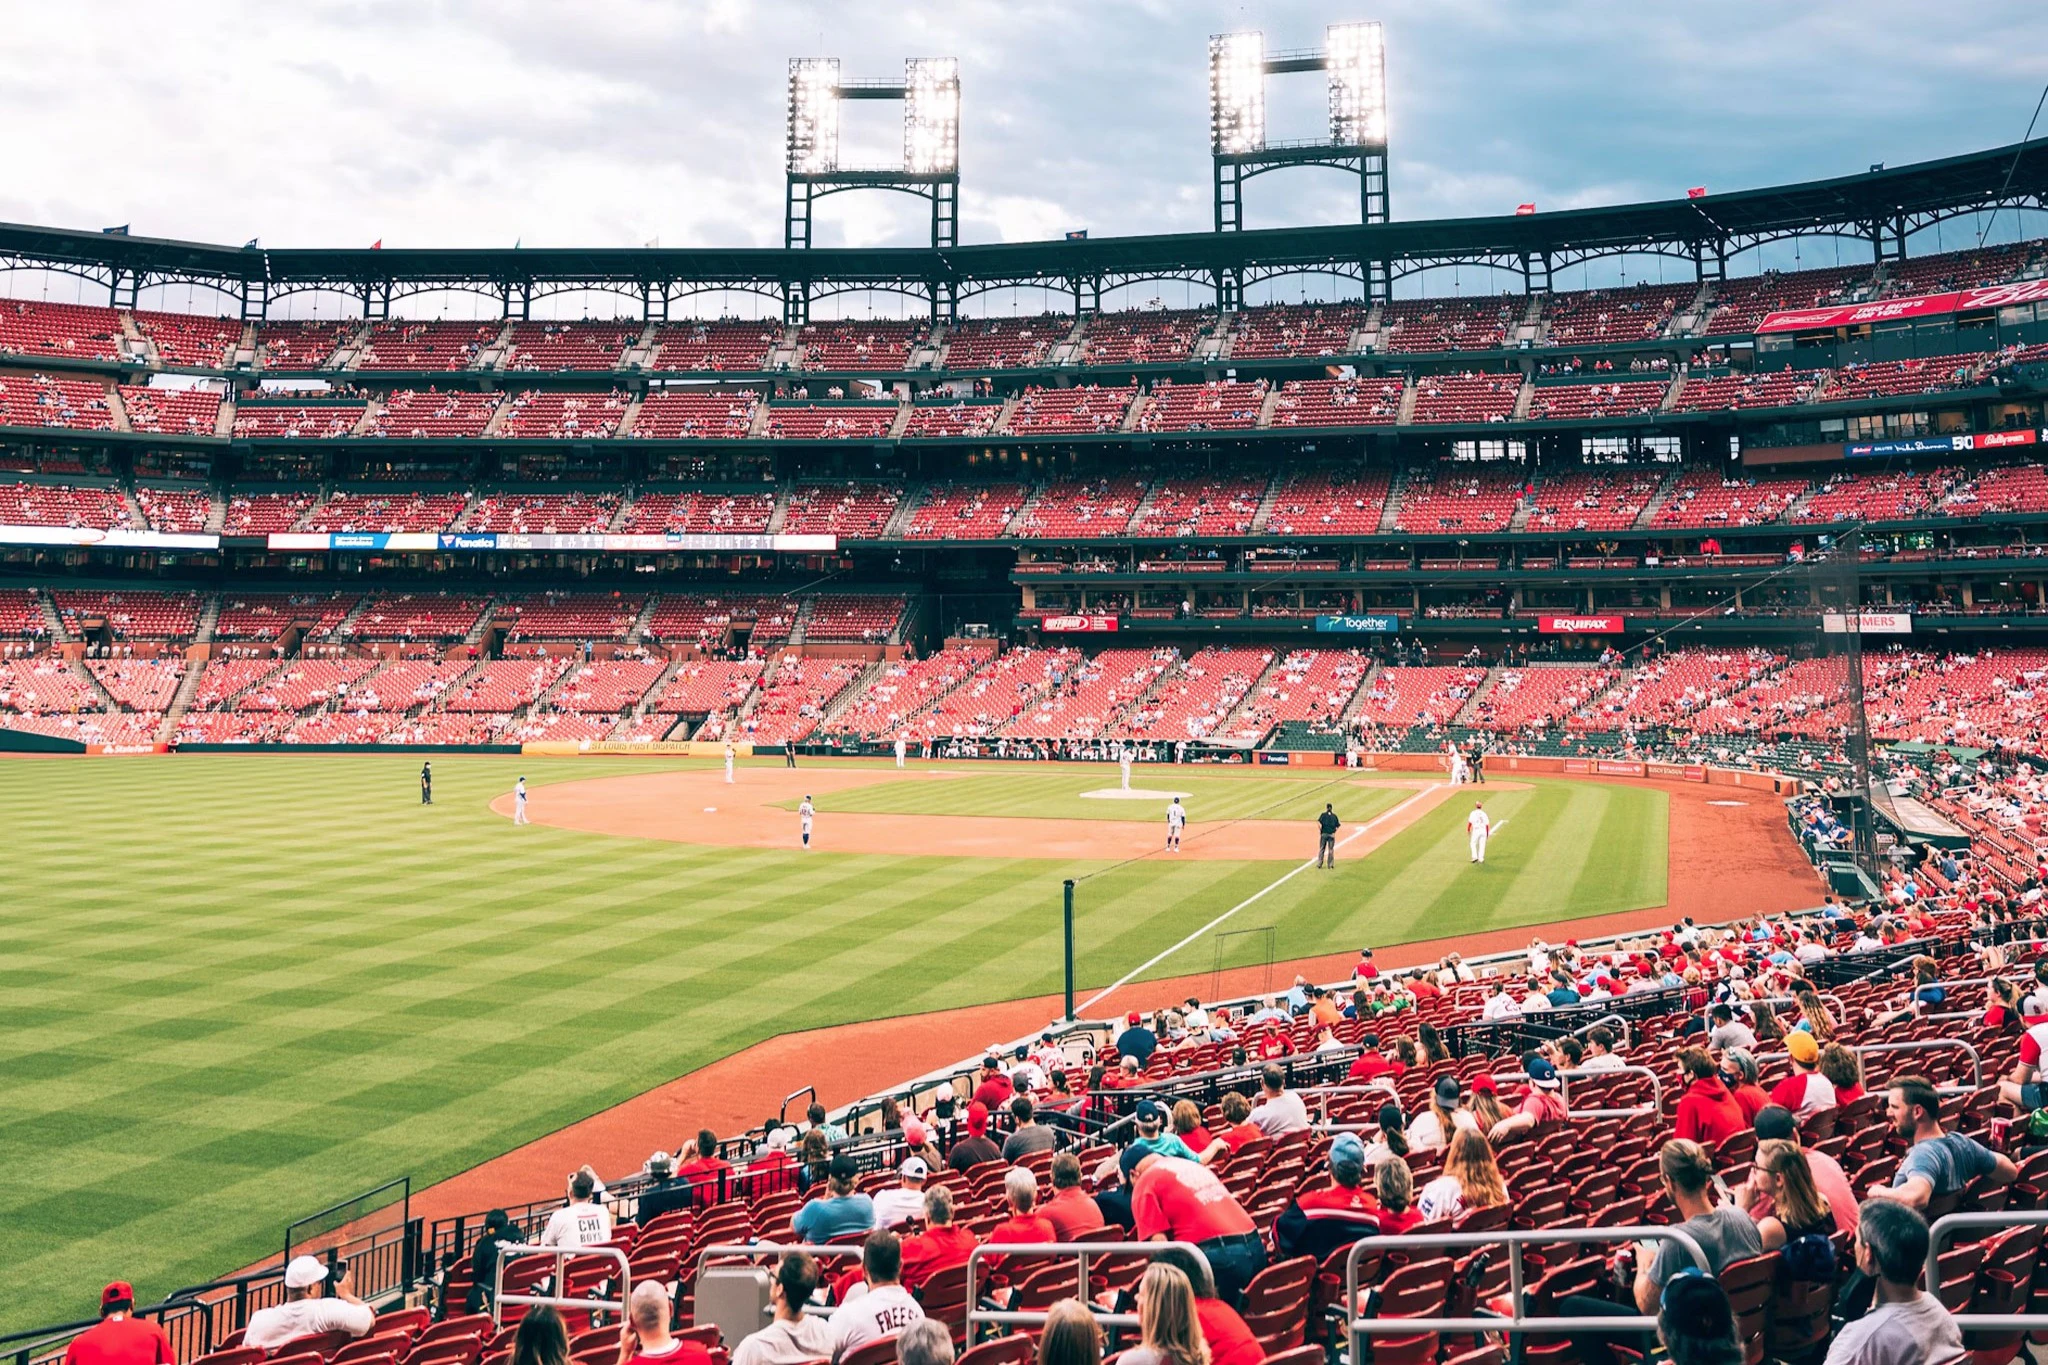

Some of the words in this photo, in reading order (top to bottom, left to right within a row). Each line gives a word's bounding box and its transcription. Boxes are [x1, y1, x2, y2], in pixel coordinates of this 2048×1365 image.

[1857, 304, 1886, 315] THIS
[1885, 299, 1925, 311] BUD'S
[1849, 311, 1875, 321] FOR
[1951, 435, 1974, 451] 50
[455, 537, 495, 548] Fanatics
[1344, 616, 1388, 630] Together
[1552, 619, 1608, 632] EQUIFAX
[1846, 616, 1896, 626] HOMERS
[603, 742, 627, 750] LOUIS
[629, 742, 650, 750] POST
[651, 742, 691, 750] DISPATCH
[1648, 765, 1664, 774] BUSCH
[1544, 1070, 1551, 1078] C
[578, 1218, 600, 1232] CHI
[579, 1232, 603, 1243] BOYS
[875, 1307, 918, 1334] FREES
